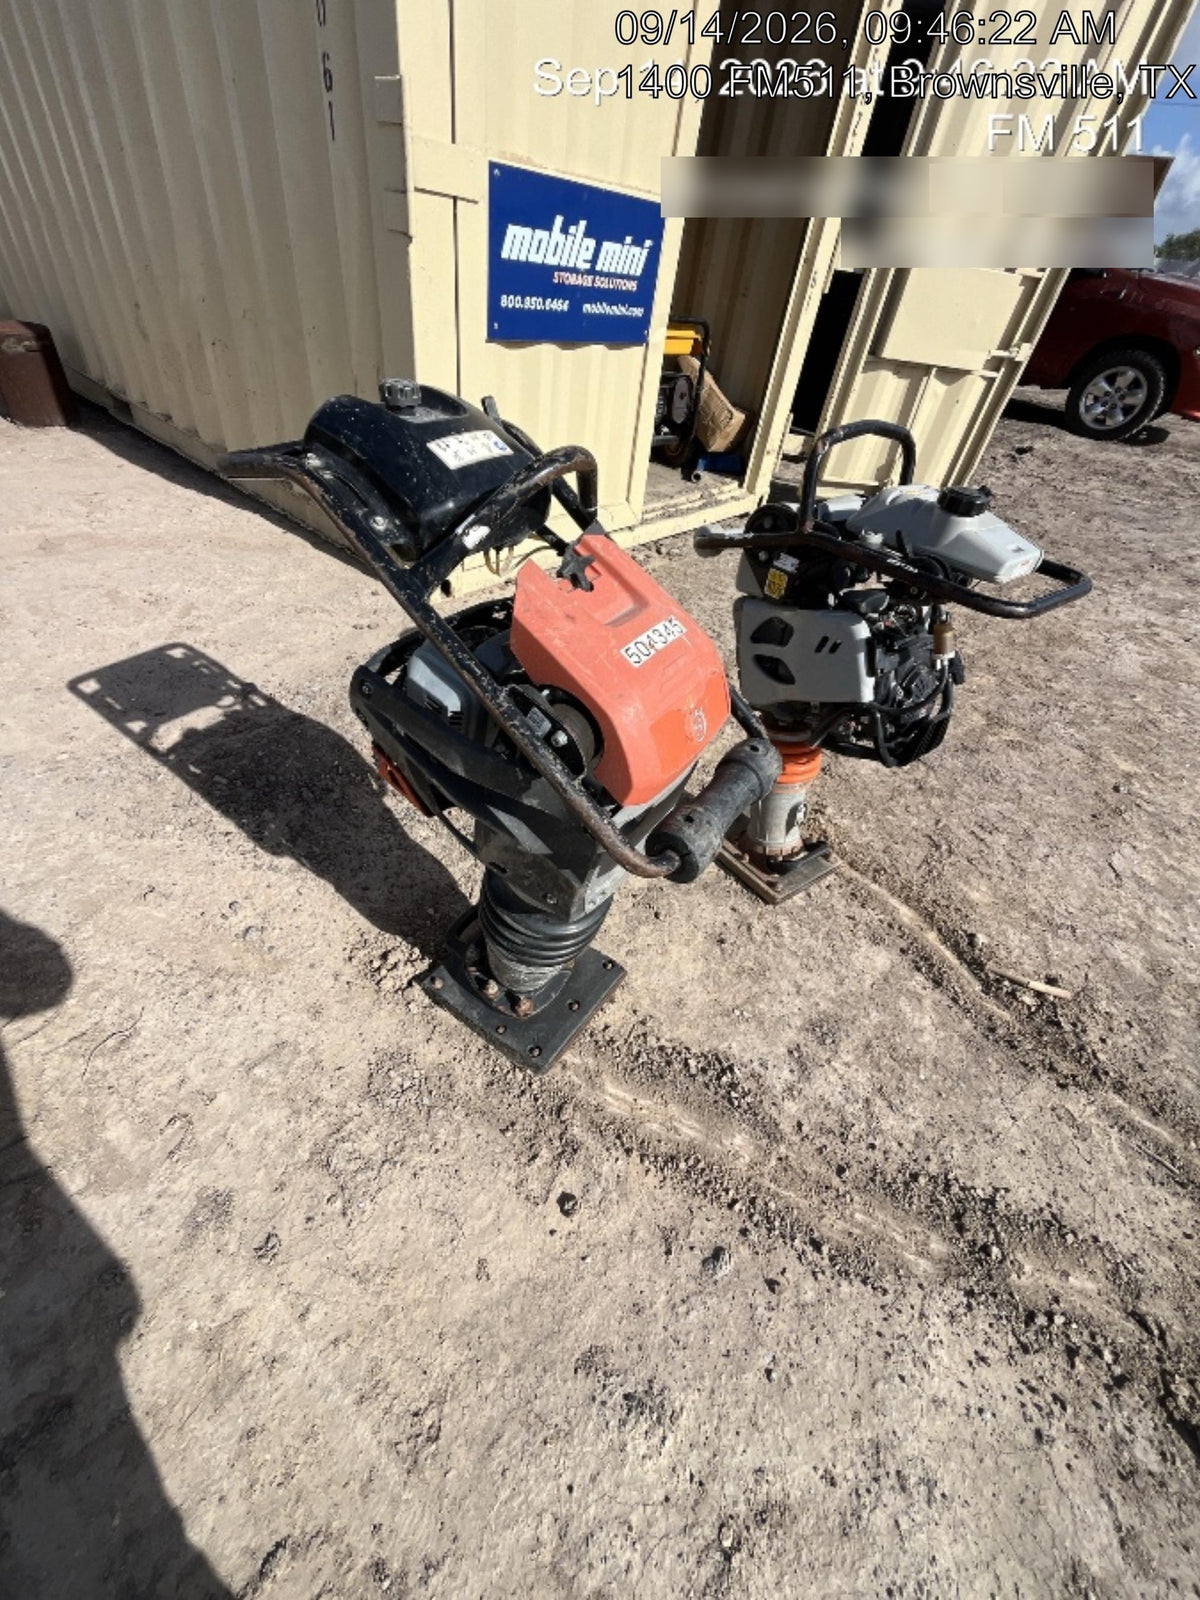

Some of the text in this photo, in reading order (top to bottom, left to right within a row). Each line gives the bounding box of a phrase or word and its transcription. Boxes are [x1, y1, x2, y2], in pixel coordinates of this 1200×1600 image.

[501, 214, 653, 277] mobile mini
[552, 271, 638, 292] STORAGE SOLUTIONS
